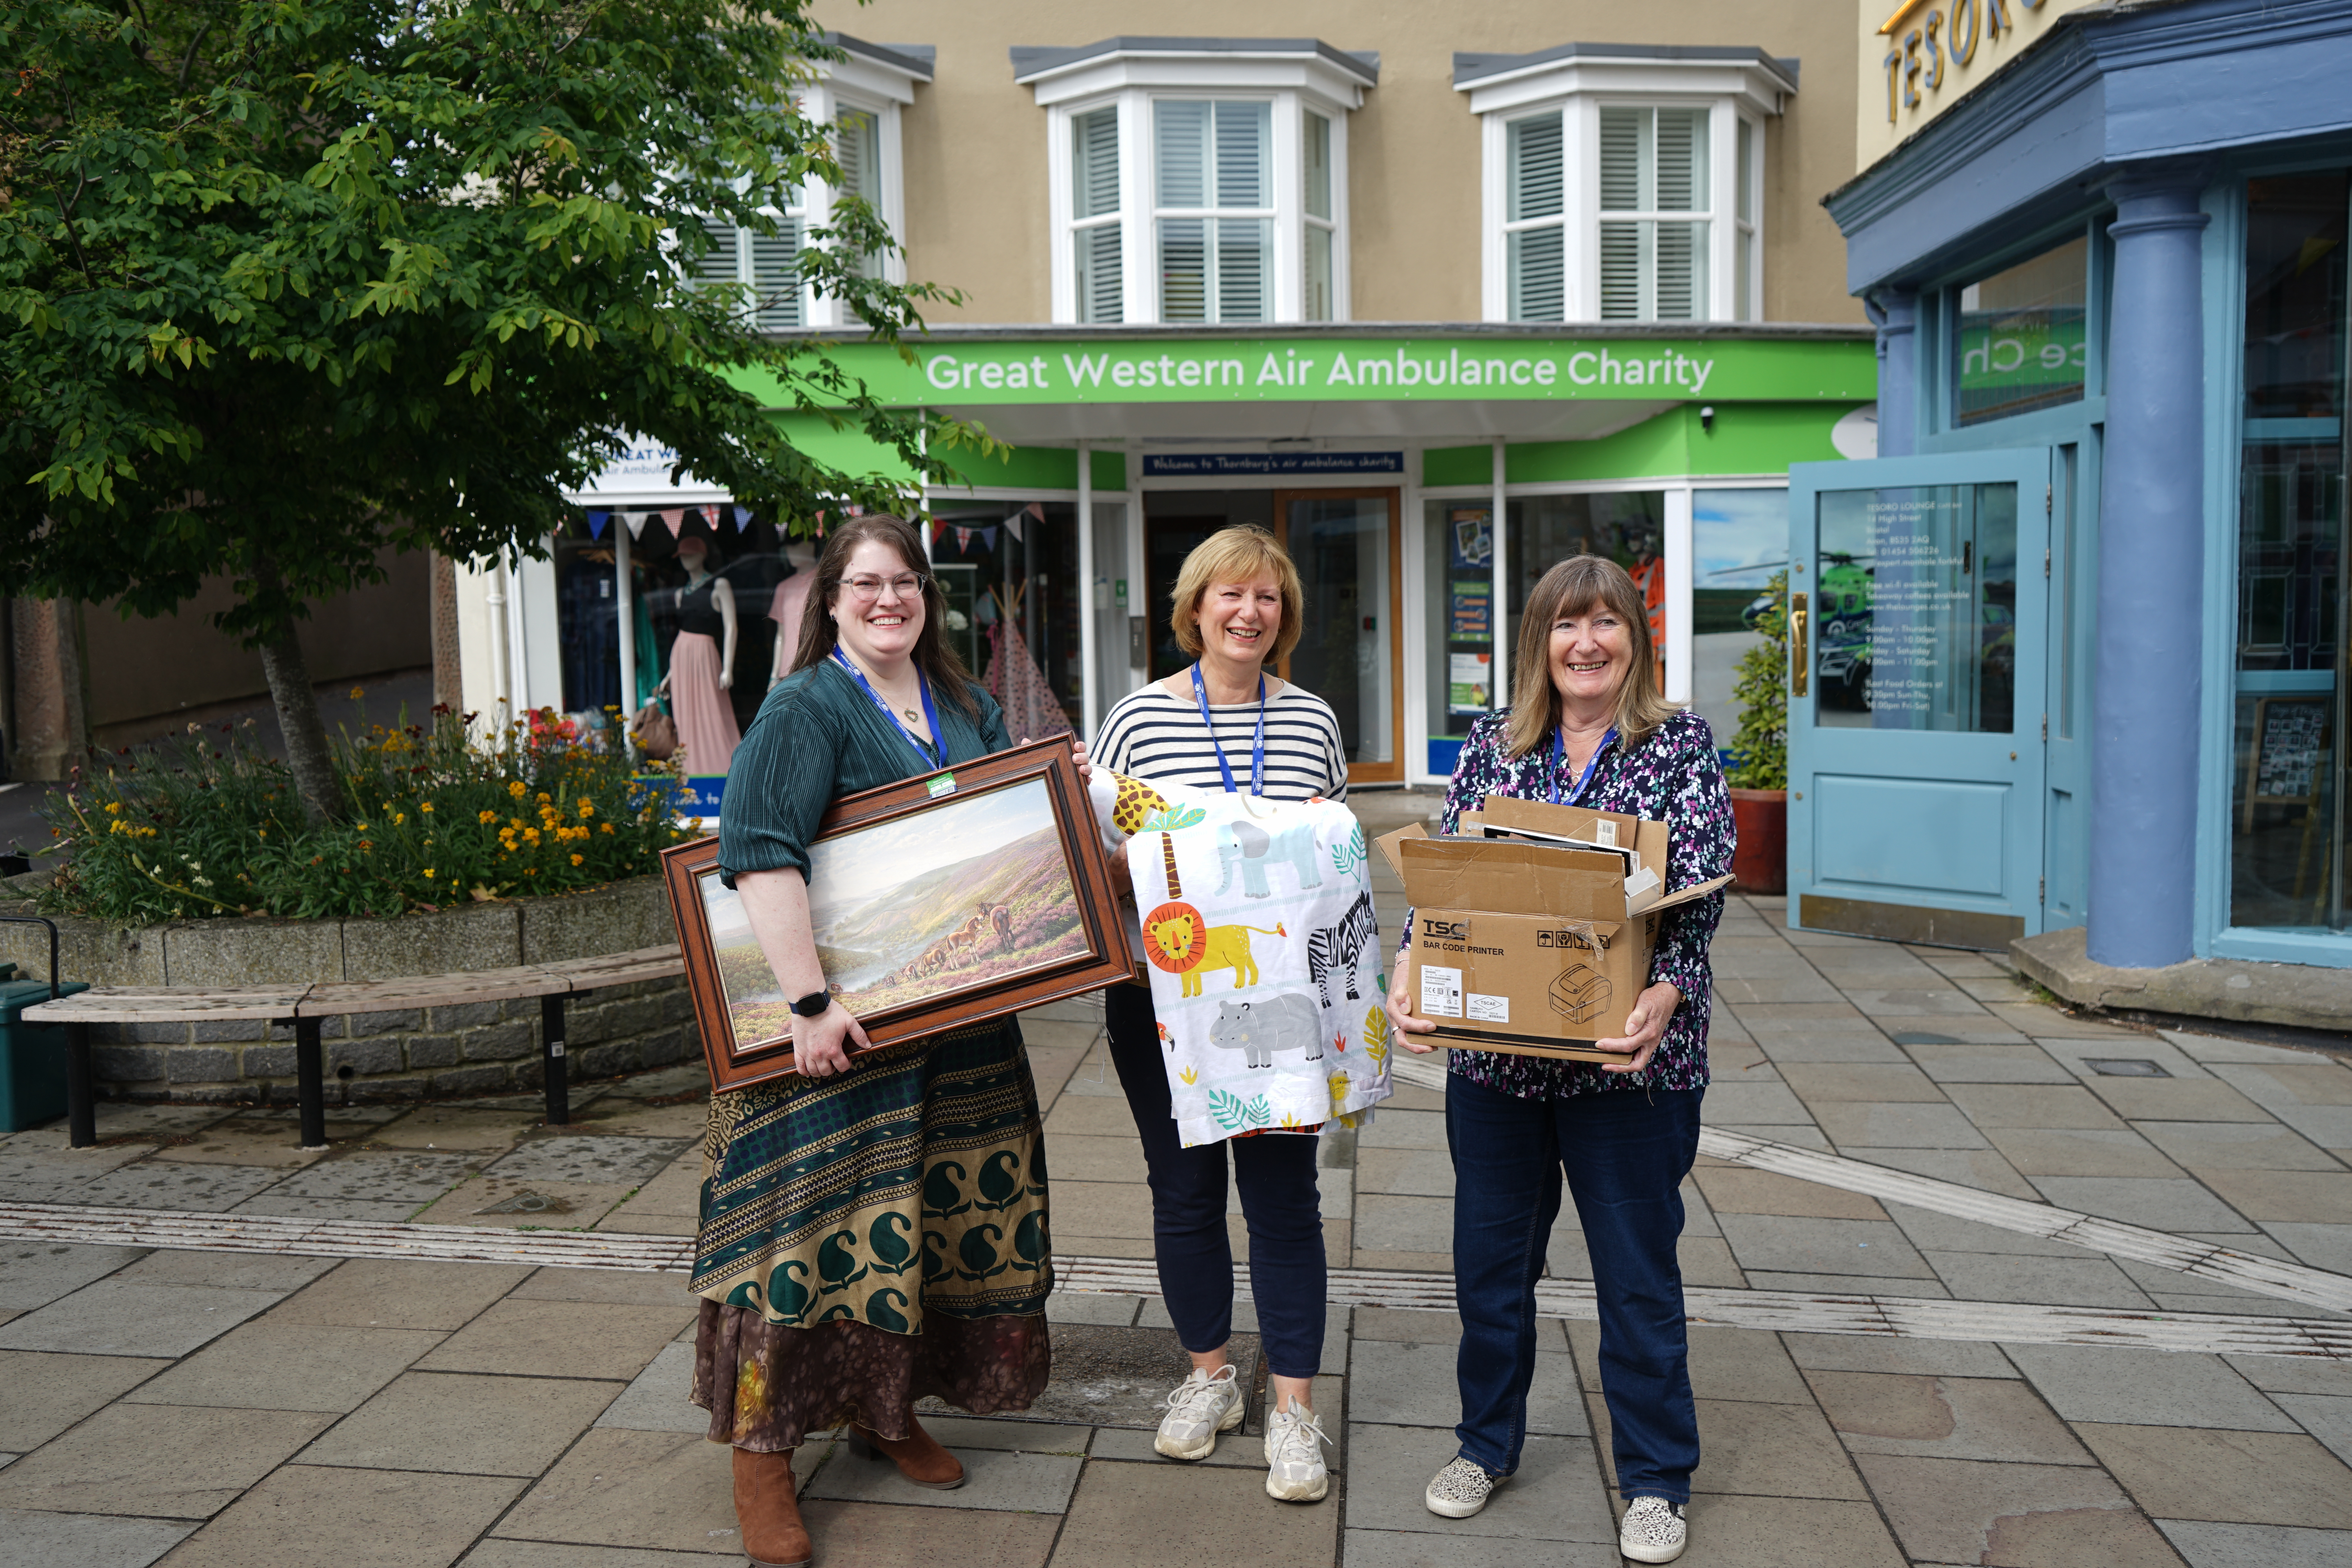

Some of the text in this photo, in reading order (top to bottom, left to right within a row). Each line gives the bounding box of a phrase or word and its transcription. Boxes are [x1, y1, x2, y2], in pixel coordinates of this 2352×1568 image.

[1884, 0, 2047, 122] TESO
[926, 348, 1713, 393] Great Western Air Ambulance Charity
[1153, 455, 1396, 472] Welcome to Thornbury's air ambulance charity
[1867, 503, 1898, 512] TESORO
[1901, 501, 1936, 511] LOUNGE
[1878, 514, 1896, 524] High
[1898, 514, 1921, 522] Street
[1889, 535, 1909, 545] BS35
[1912, 535, 1929, 544] 2AQ
[1880, 547, 1906, 556] 01454
[1909, 546, 1939, 555] 506226
[1903, 580, 1939, 588] available
[1866, 591, 1970, 601] Takeaway coffees available
[1866, 602, 1951, 612] www.thelounges.co.uk
[1866, 624, 1894, 634] Sunday
[1901, 624, 1936, 634] Thursday
[1865, 635, 1895, 644] 9.00am
[1904, 635, 1938, 644] 10.00pm
[1866, 646, 1889, 657] Friday
[1896, 646, 1931, 657] Saturday
[1865, 657, 1895, 666] 9.00am
[1903, 657, 1938, 666] 11.00pm
[1885, 679, 1904, 688] Food
[1906, 679, 1933, 688] Orders
[1865, 690, 1895, 699] 9.30pm
[1866, 701, 1900, 710] 10.00pm
[706, 792, 720, 805] to
[1423, 919, 1465, 936] TSC
[1646, 917, 1655, 931] TSC
[1423, 941, 1504, 956] BAR CODE PRINTER
